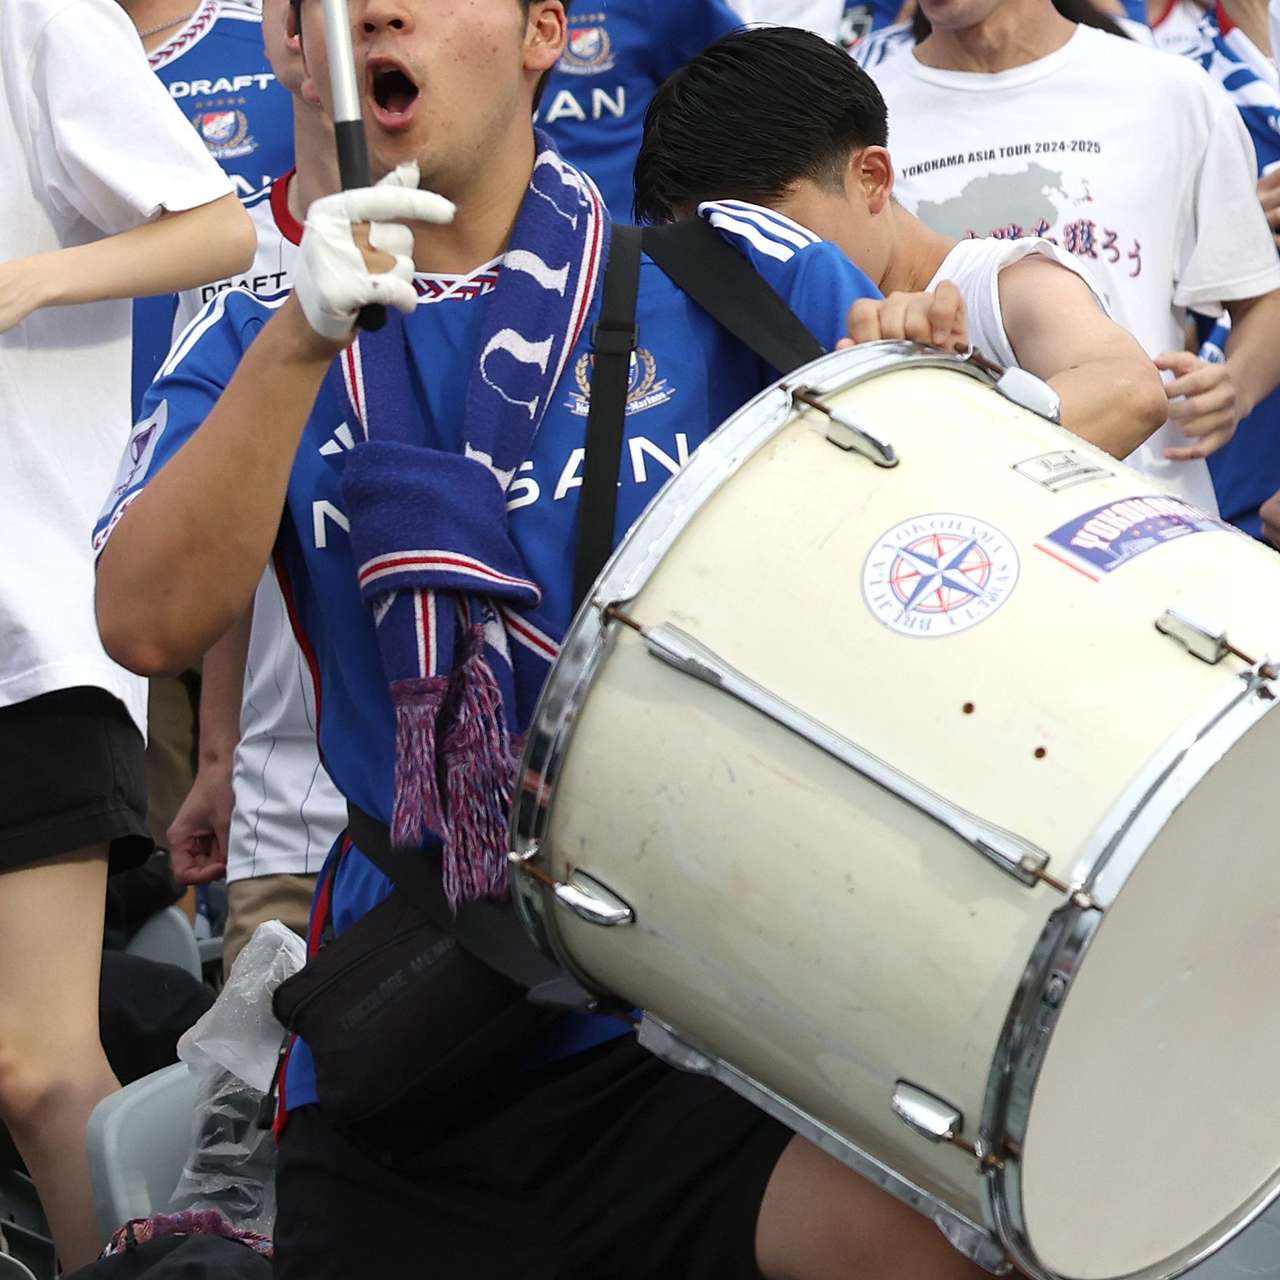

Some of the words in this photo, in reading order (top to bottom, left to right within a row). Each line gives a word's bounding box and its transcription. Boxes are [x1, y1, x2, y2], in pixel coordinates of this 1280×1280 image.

[168, 73, 276, 98] DRAFT
[902, 154, 965, 179] YOKOHAMA
[968, 150, 996, 164] ASIA
[1000, 143, 1031, 158] TOUR
[1035, 140, 1101, 154] 2024-2025
